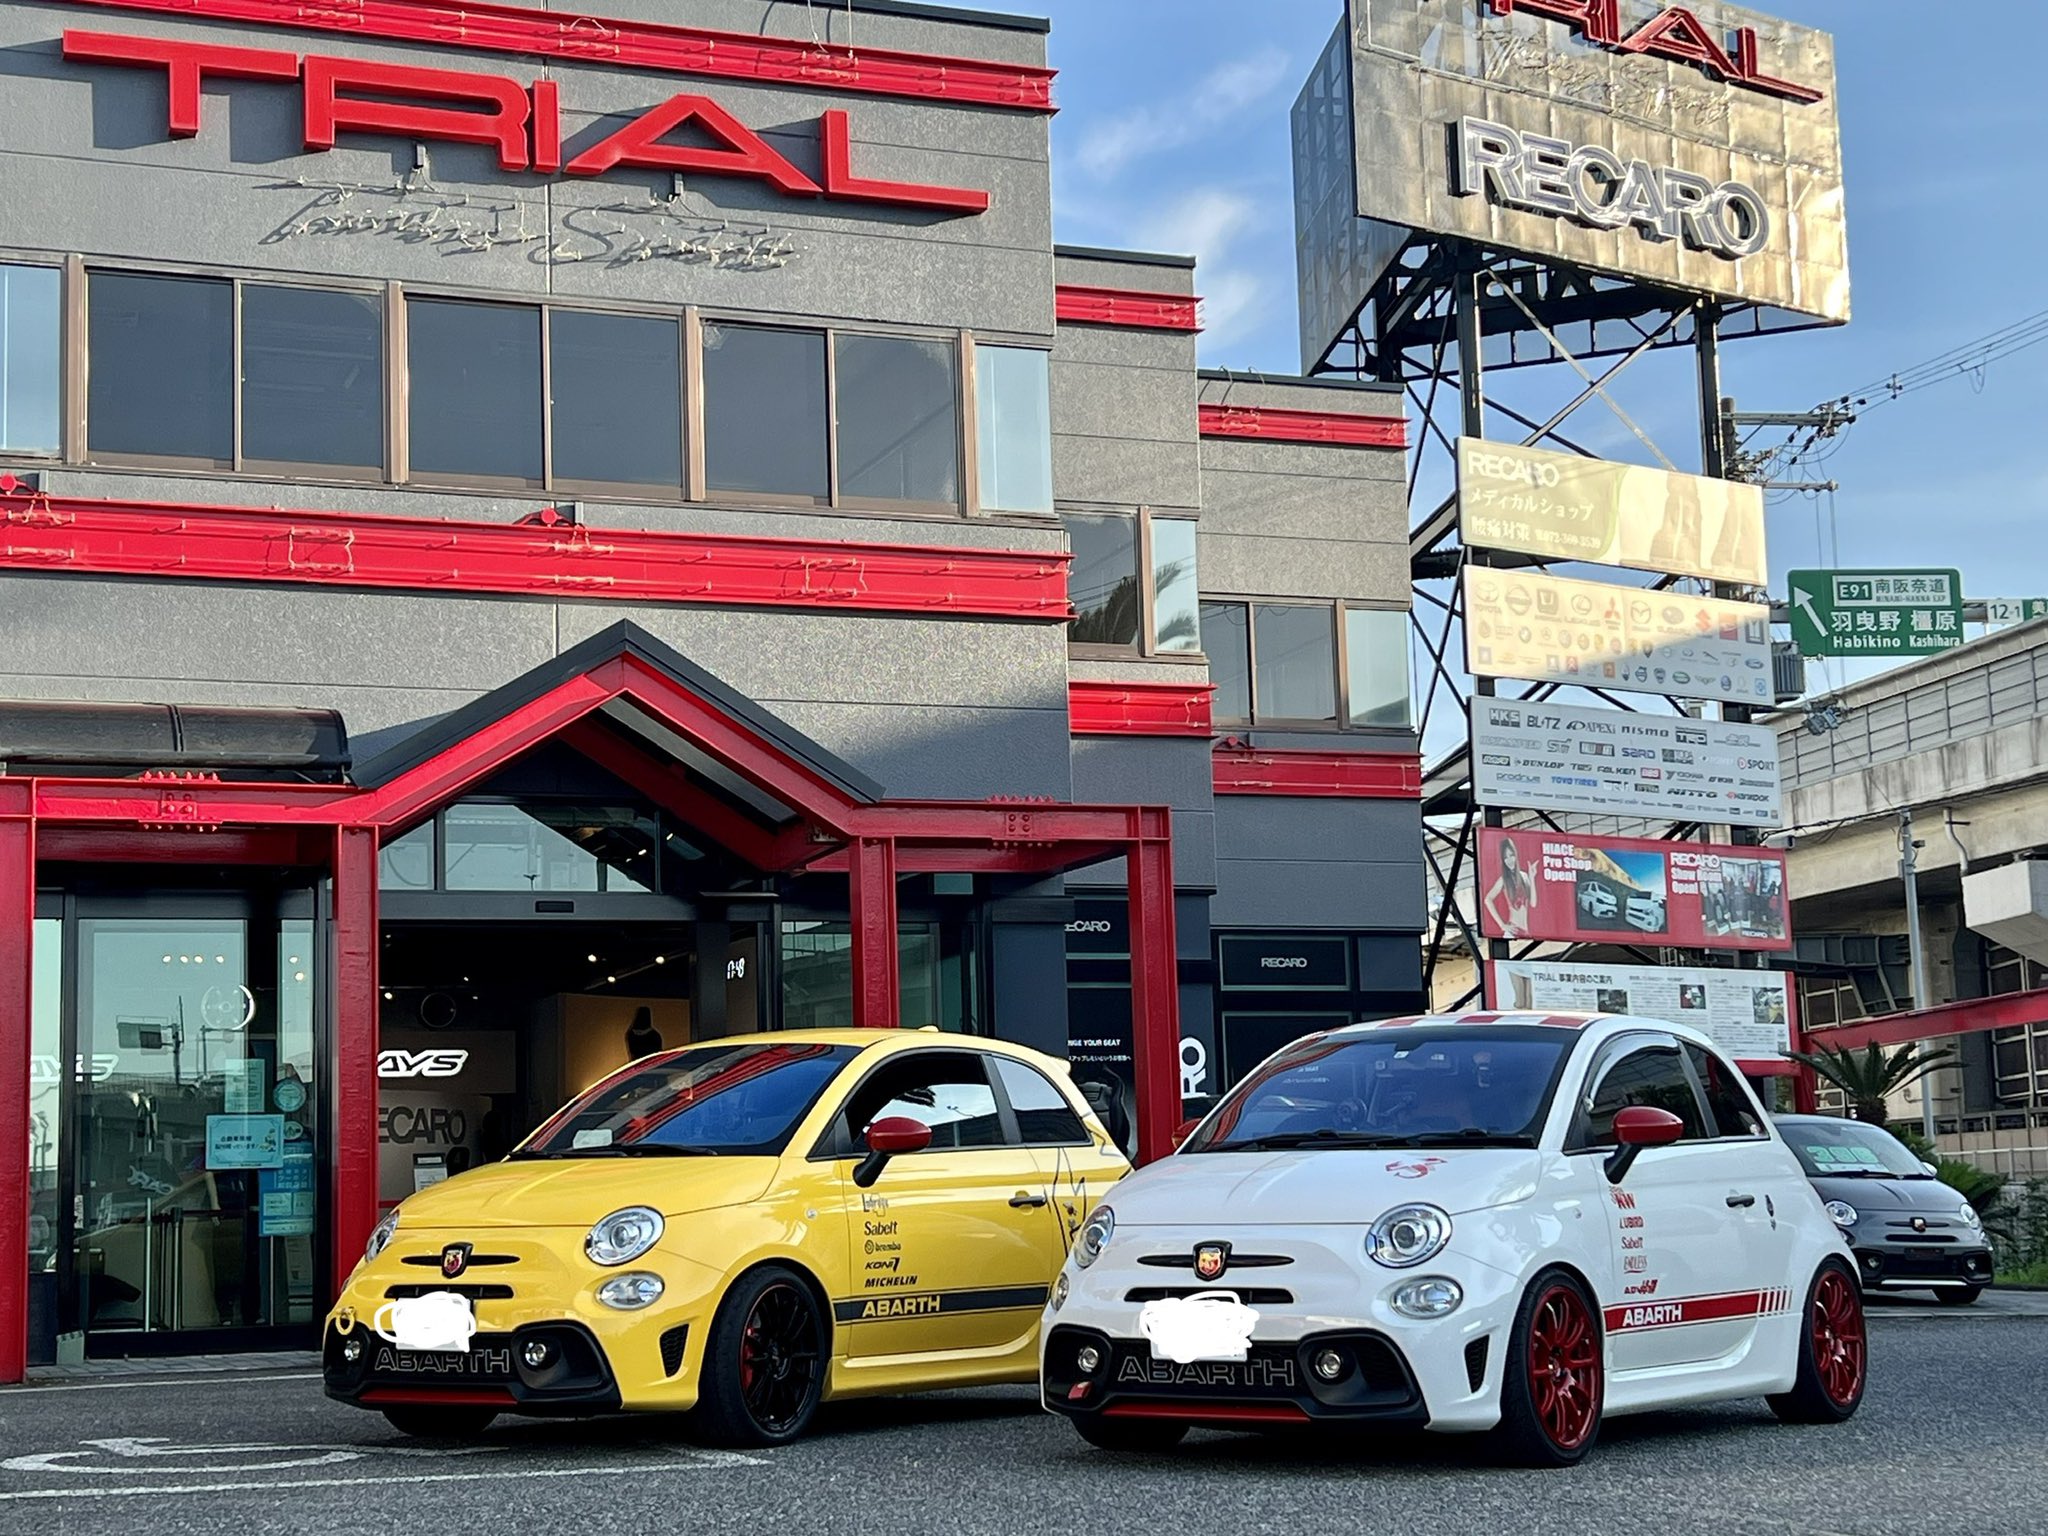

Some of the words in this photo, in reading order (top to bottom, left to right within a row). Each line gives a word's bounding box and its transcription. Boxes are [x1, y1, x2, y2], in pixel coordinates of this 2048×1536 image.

[63, 29, 989, 214] TRIAL
[1453, 115, 1770, 258] RECARO
[1470, 487, 1594, 521] メディカルショップ
[1839, 584, 1870, 599] E91
[1874, 578, 1946, 594] 南阪奈道
[1990, 604, 2021, 619] 12-1
[1830, 610, 1902, 632] 羽曳野
[1833, 635, 1901, 648] Habikino
[1909, 634, 1960, 648] Kashihara
[1489, 707, 1520, 724] HKS
[1522, 759, 1564, 769] DUNLOP
[1542, 842, 1574, 856] HIACE
[1543, 855, 1562, 868] Pro
[1563, 856, 1592, 871] Shop
[1670, 852, 1720, 869] RECARO
[1261, 957, 1308, 968] RECARO
[1083, 1038, 1102, 1047] YOUR
[1103, 1038, 1121, 1047] SEAT
[863, 1220, 898, 1236] Sabelt
[864, 1260, 894, 1271] KONI
[864, 1275, 918, 1288] MICHELIN
[862, 1295, 941, 1319] ABARTH
[1621, 1304, 1683, 1327] ABARTH
[374, 1347, 510, 1374] ABARTH
[1117, 1355, 1295, 1386] ABARTH
